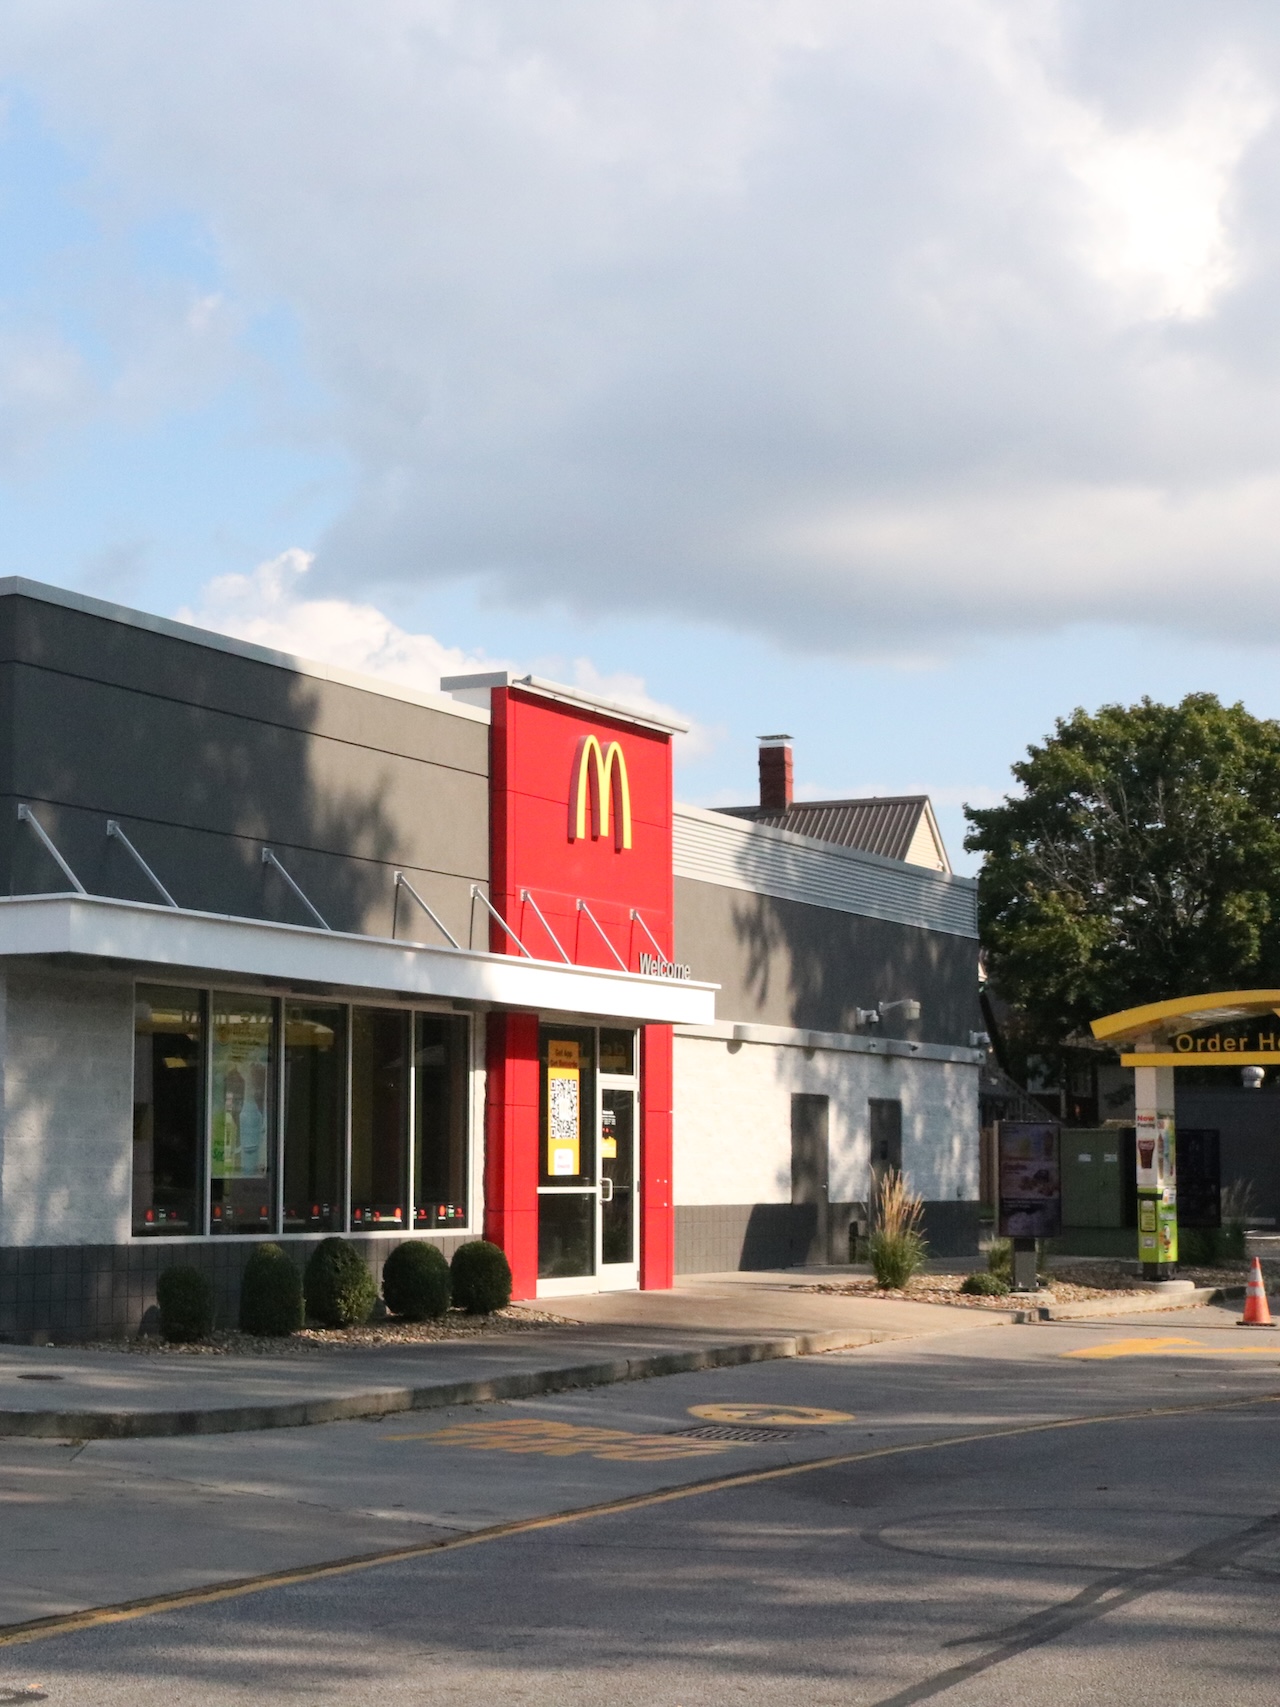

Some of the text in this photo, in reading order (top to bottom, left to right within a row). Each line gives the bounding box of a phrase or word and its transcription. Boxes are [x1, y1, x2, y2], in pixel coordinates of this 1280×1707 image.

[639, 951, 691, 980] Welcome
[1175, 1032, 1280, 1052] Order H
